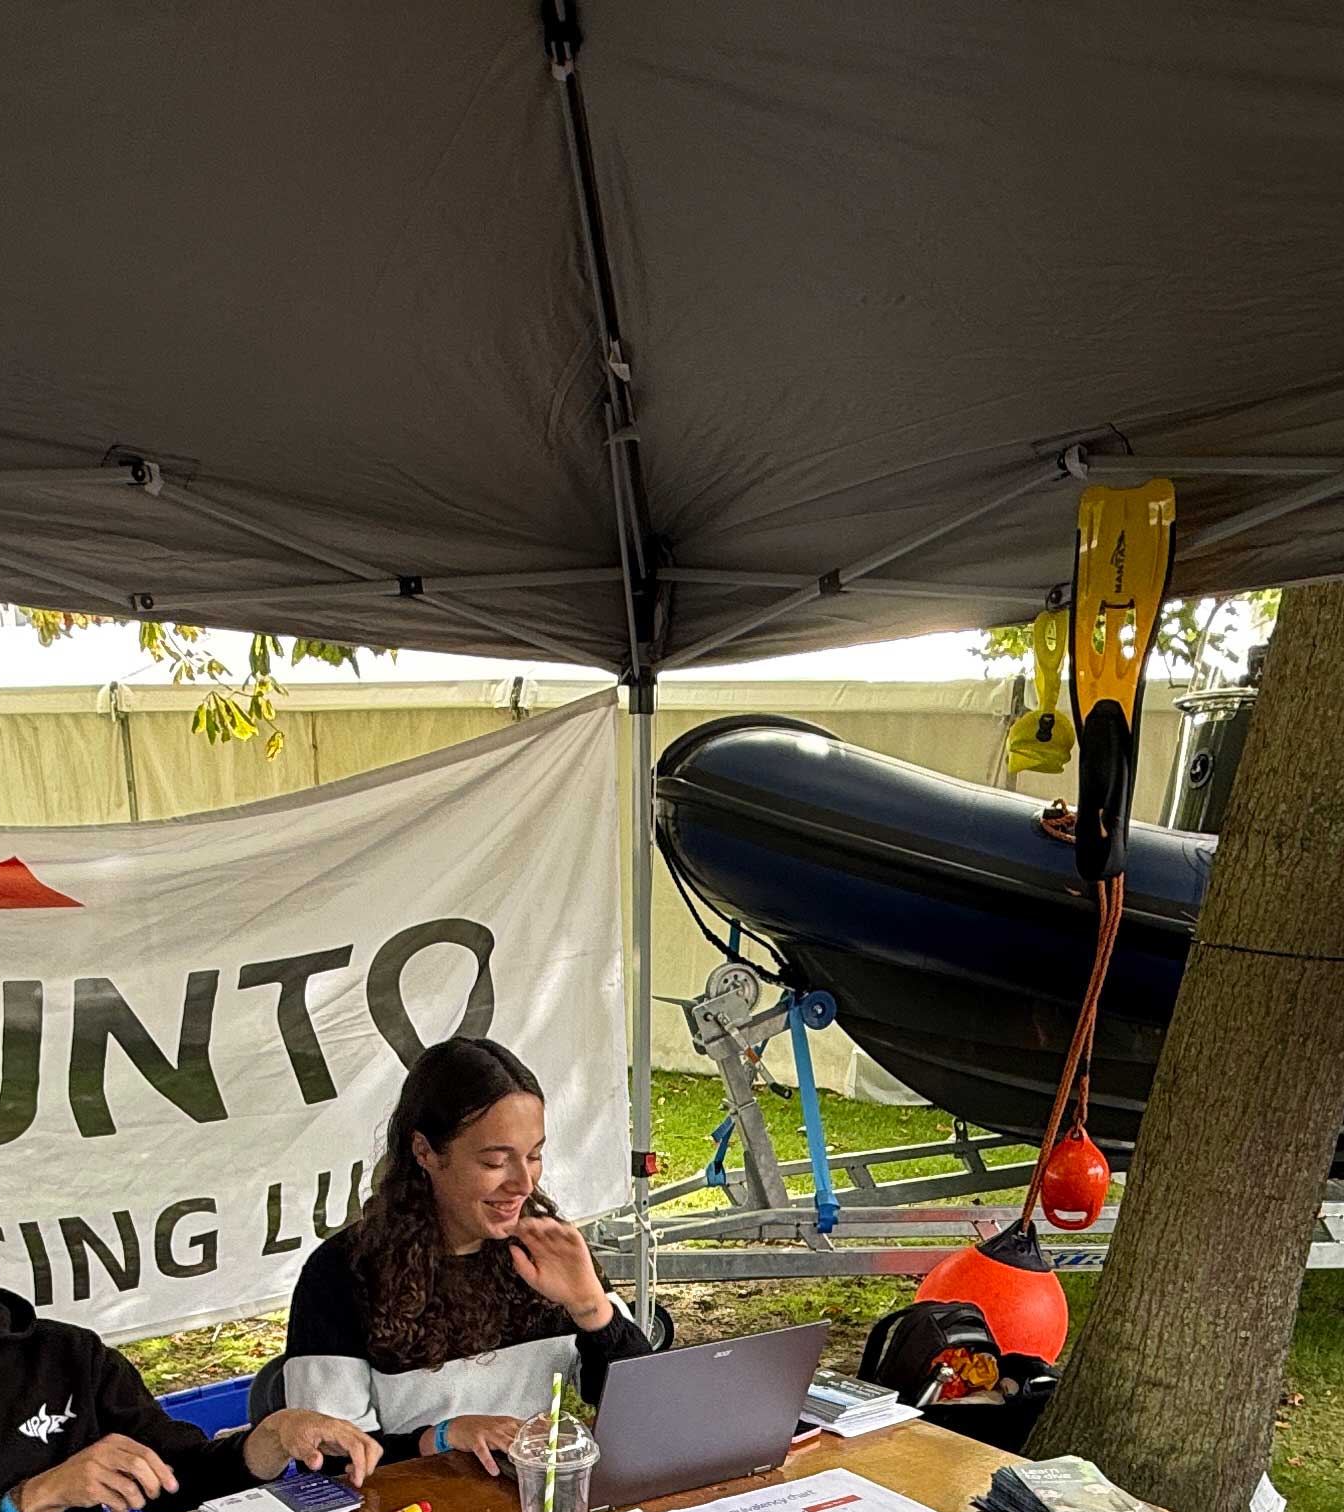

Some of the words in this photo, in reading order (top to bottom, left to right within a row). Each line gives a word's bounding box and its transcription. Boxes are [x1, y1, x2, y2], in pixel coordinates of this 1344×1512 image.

[262, 1158, 365, 1256] LU
[713, 1349, 734, 1359] acer
[1020, 1467, 1061, 1476] Learn
[1025, 1473, 1042, 1481] to
[1043, 1472, 1073, 1480] dive
[787, 1488, 816, 1502] chart
